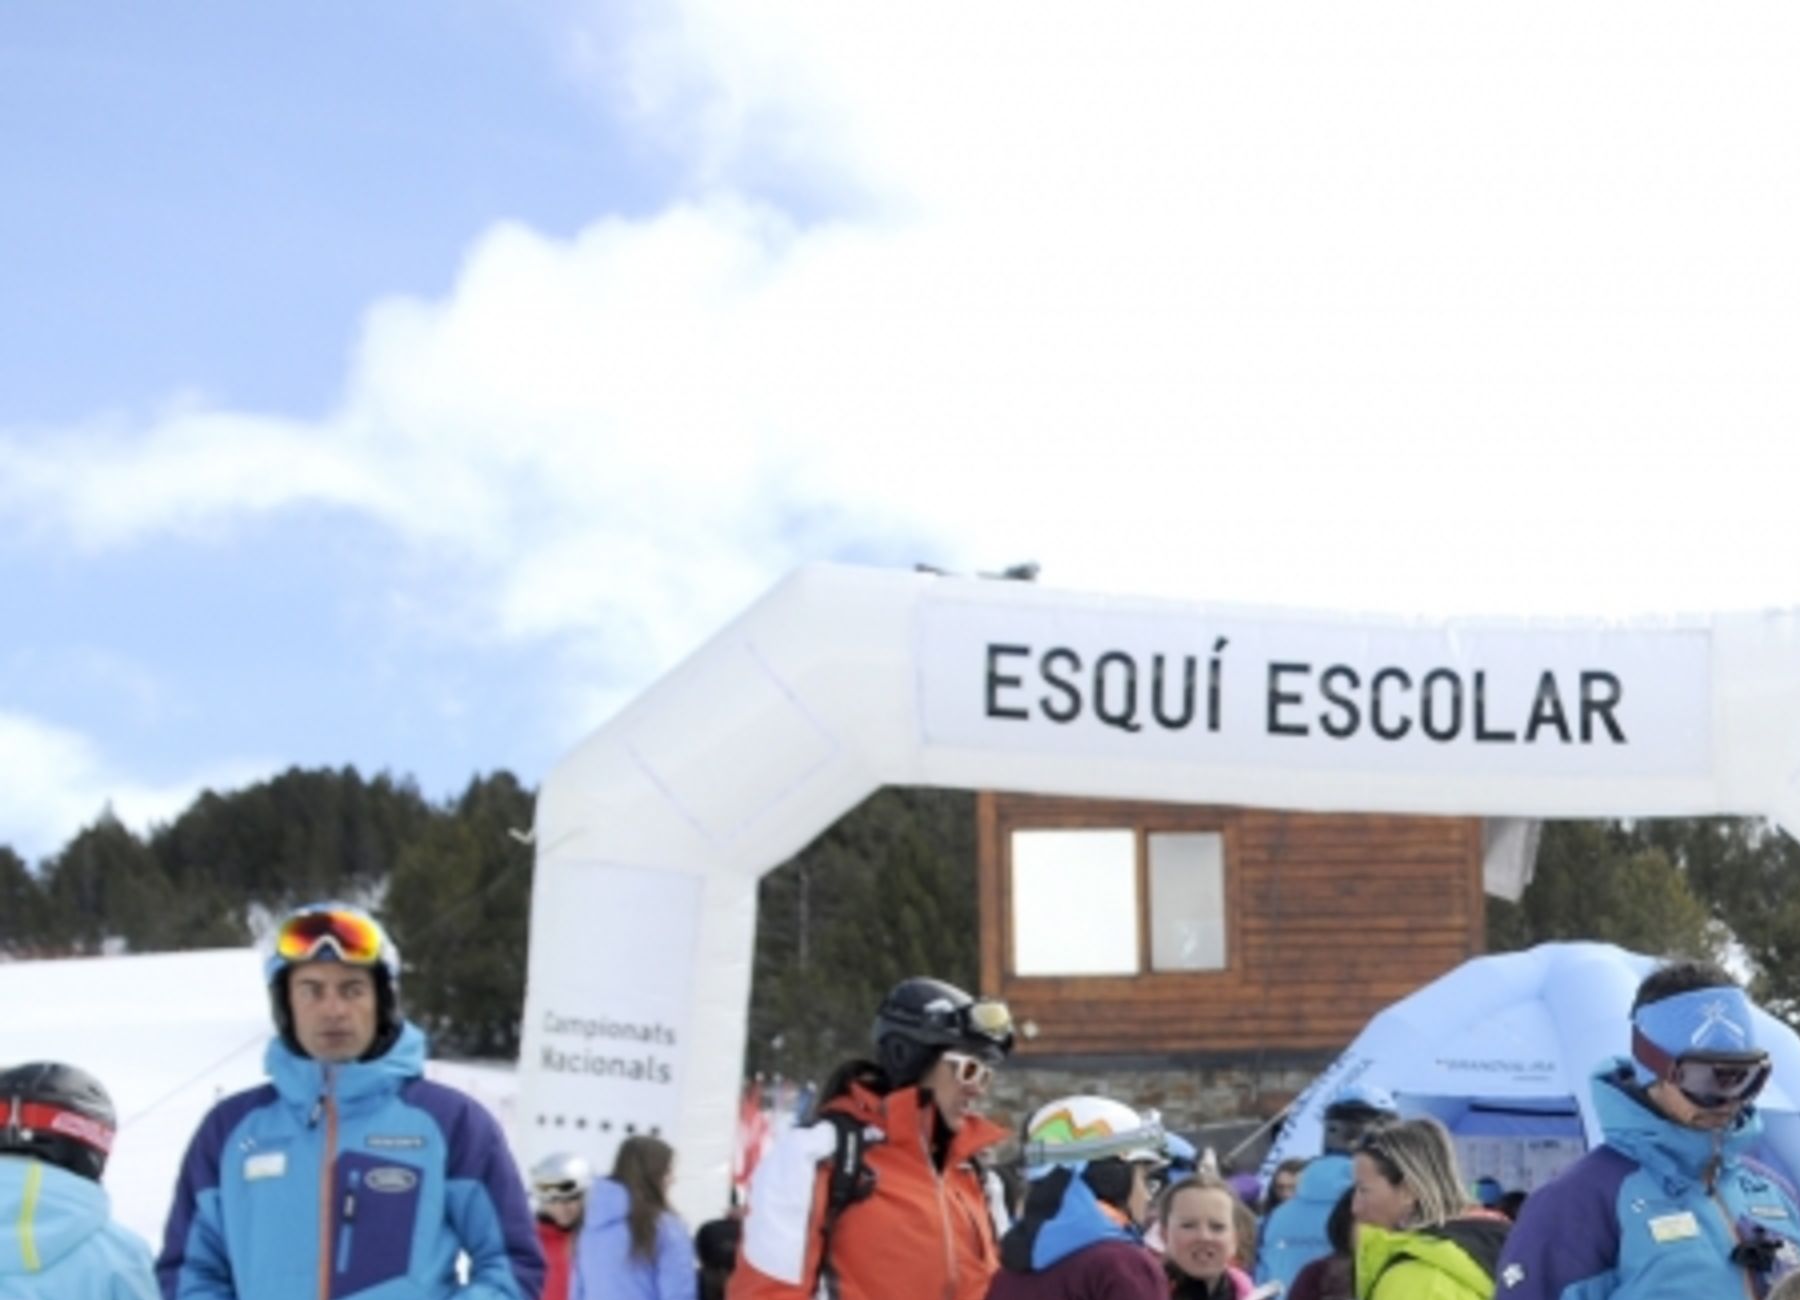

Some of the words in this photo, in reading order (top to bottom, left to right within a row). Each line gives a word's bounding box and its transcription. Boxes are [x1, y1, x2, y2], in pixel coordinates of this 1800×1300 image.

[984, 636, 1229, 732] ESQUÍ
[1265, 661, 1628, 744] ESCOLAR
[545, 1010, 676, 1045] Campionats
[541, 1046, 672, 1084] Nacionals
